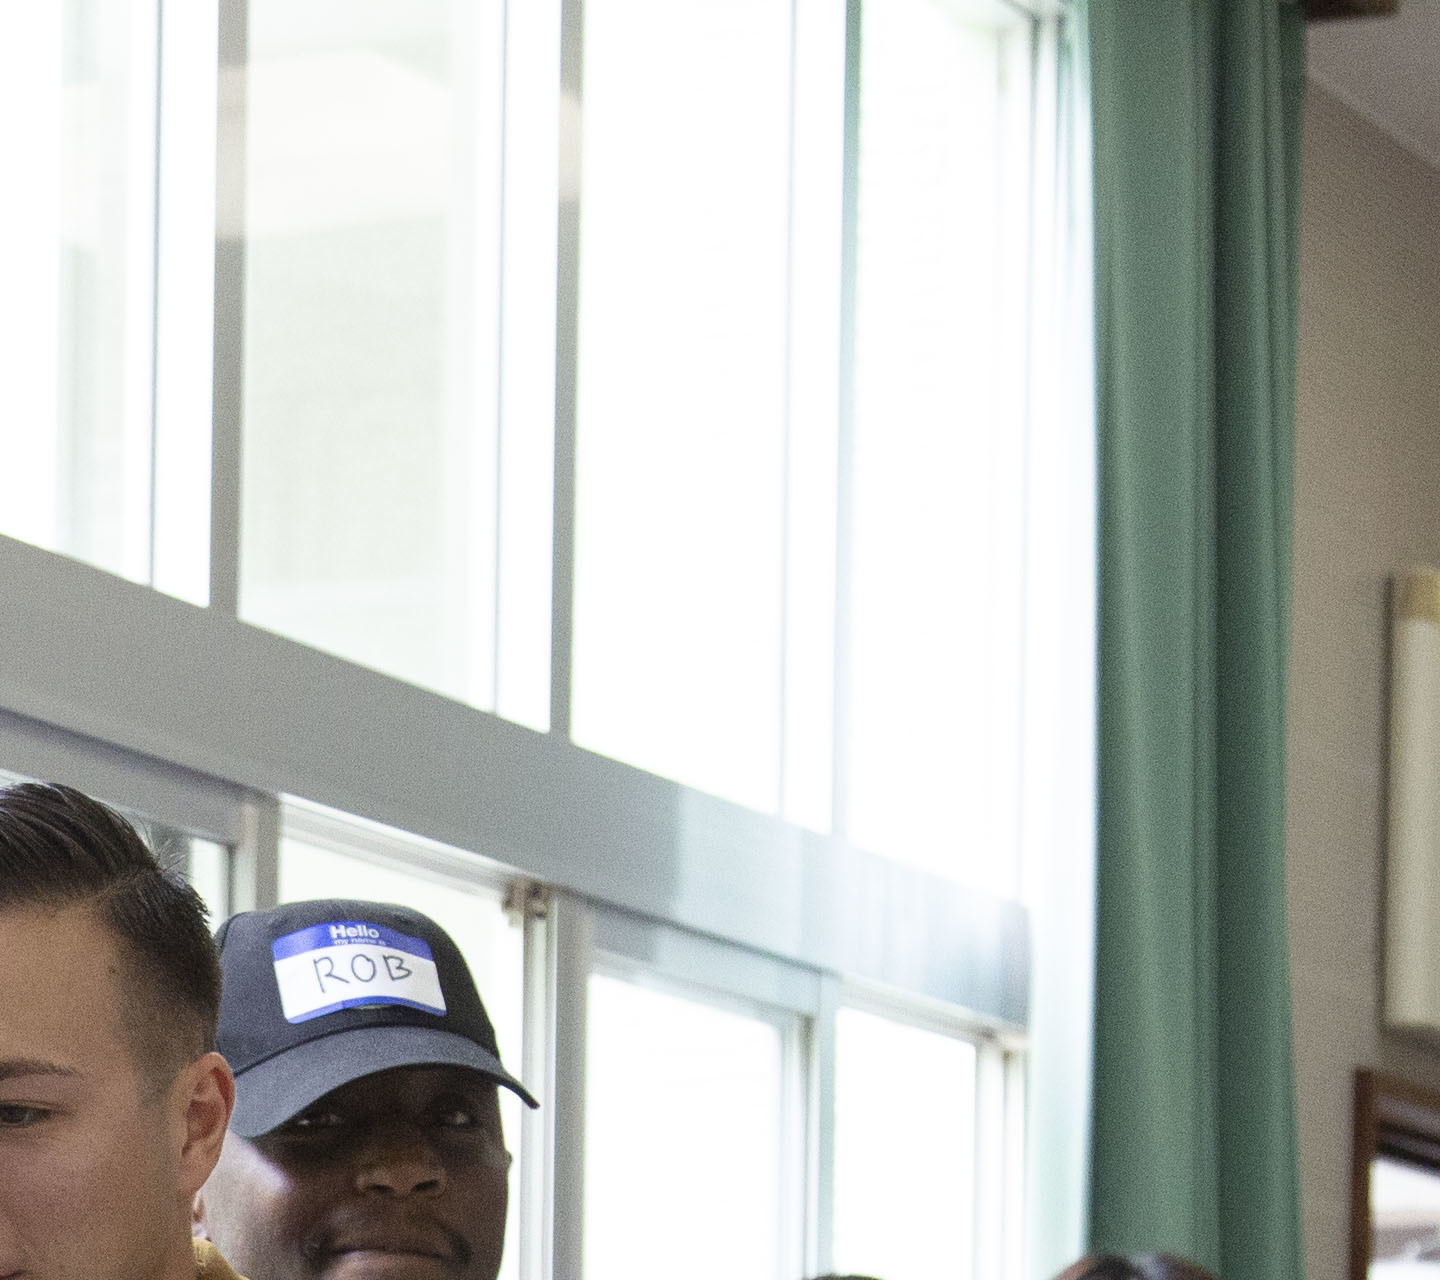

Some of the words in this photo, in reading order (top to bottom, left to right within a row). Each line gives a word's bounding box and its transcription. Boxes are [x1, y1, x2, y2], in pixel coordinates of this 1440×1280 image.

[329, 924, 380, 939] Hello
[333, 938, 349, 946] my
[351, 937, 378, 945] name
[313, 953, 413, 994] ROB
